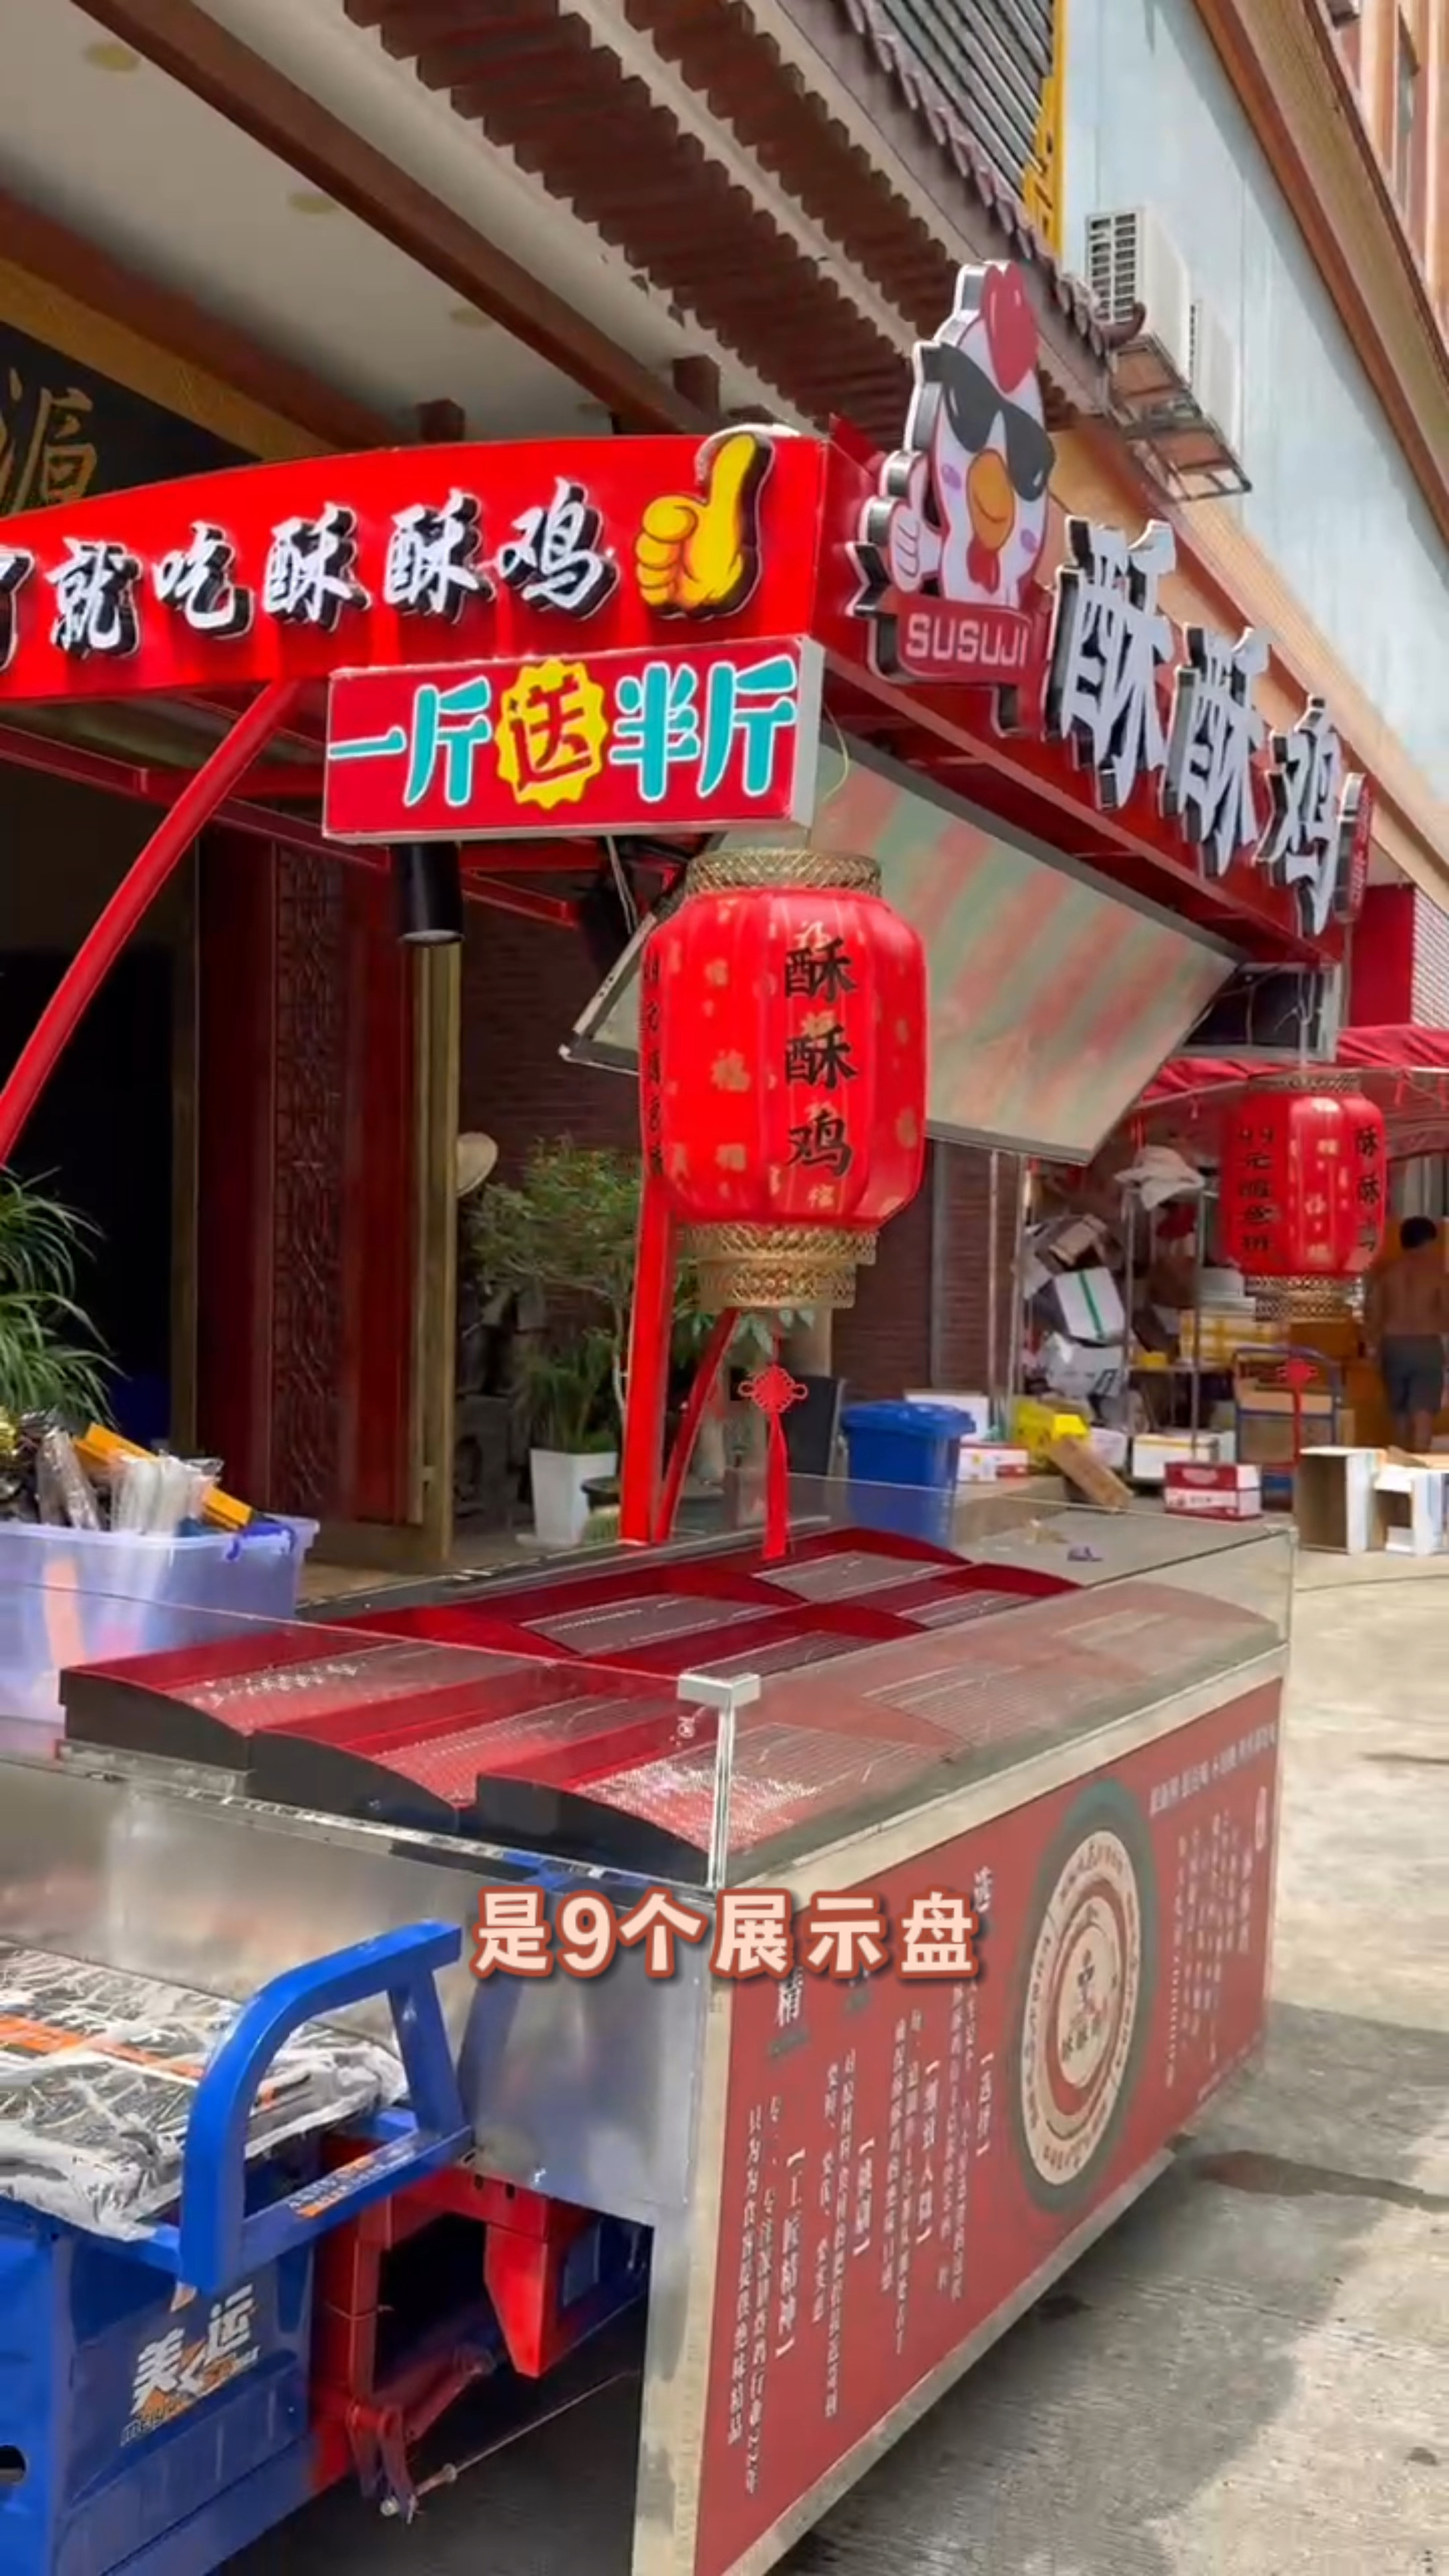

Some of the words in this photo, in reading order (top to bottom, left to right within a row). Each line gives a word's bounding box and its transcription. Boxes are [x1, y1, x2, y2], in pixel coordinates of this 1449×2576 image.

[0, 476, 614, 671] 就吃酥酥鸡
[906, 612, 1030, 667] SUSUJI
[327, 653, 798, 808] 一斤送半斤
[1048, 515, 1343, 936] 酥酥鸡
[784, 936, 858, 1177] 酥酥鸡
